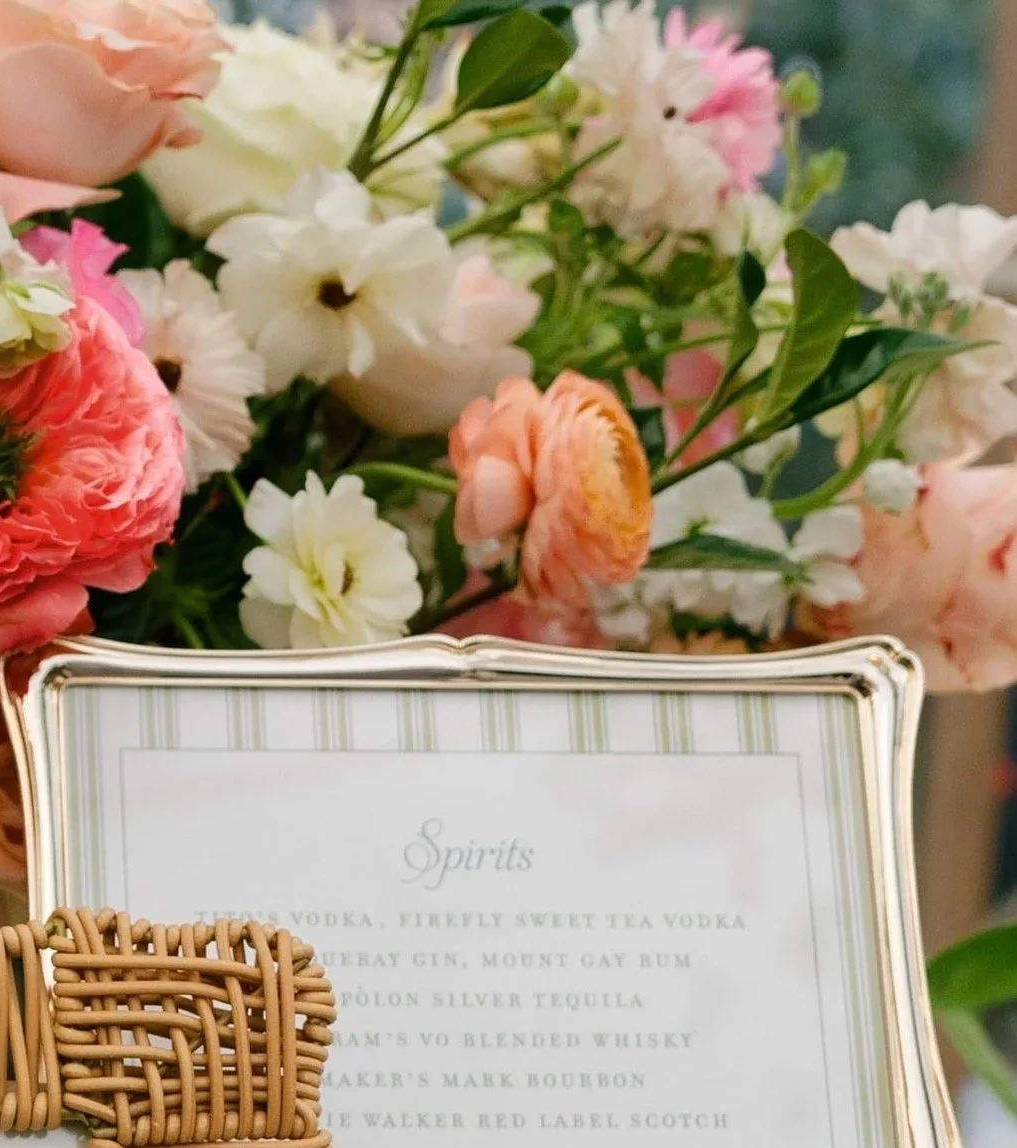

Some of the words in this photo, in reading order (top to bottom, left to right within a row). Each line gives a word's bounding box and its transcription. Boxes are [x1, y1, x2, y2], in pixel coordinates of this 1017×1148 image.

[401, 818, 534, 891] Spirits
[290, 911, 384, 930] VODKA,
[399, 912, 502, 928] FIREFLY
[516, 913, 595, 929] SWEET
[606, 913, 653, 929] TEA
[664, 913, 746, 930] VODKA
[321, 952, 399, 968] UERAY
[413, 952, 469, 972] GIN,
[482, 952, 568, 968] MOUNT
[580, 953, 625, 968] GAY
[639, 953, 691, 969] RUM
[341, 986, 418, 1007] PÒLON
[433, 992, 521, 1008] SILVER
[533, 992, 643, 1012] TEQUILA
[419, 1032, 449, 1047] VO
[464, 1032, 580, 1048] BLENDED
[592, 1032, 692, 1048] WHISKY
[442, 1072, 514, 1088] MARK
[528, 1073, 645, 1089] BOURBON
[363, 1113, 464, 1128] WALKER
[478, 1113, 525, 1129] RED
[539, 1113, 618, 1128] LABEL
[630, 1113, 728, 1129] SCOTCH
